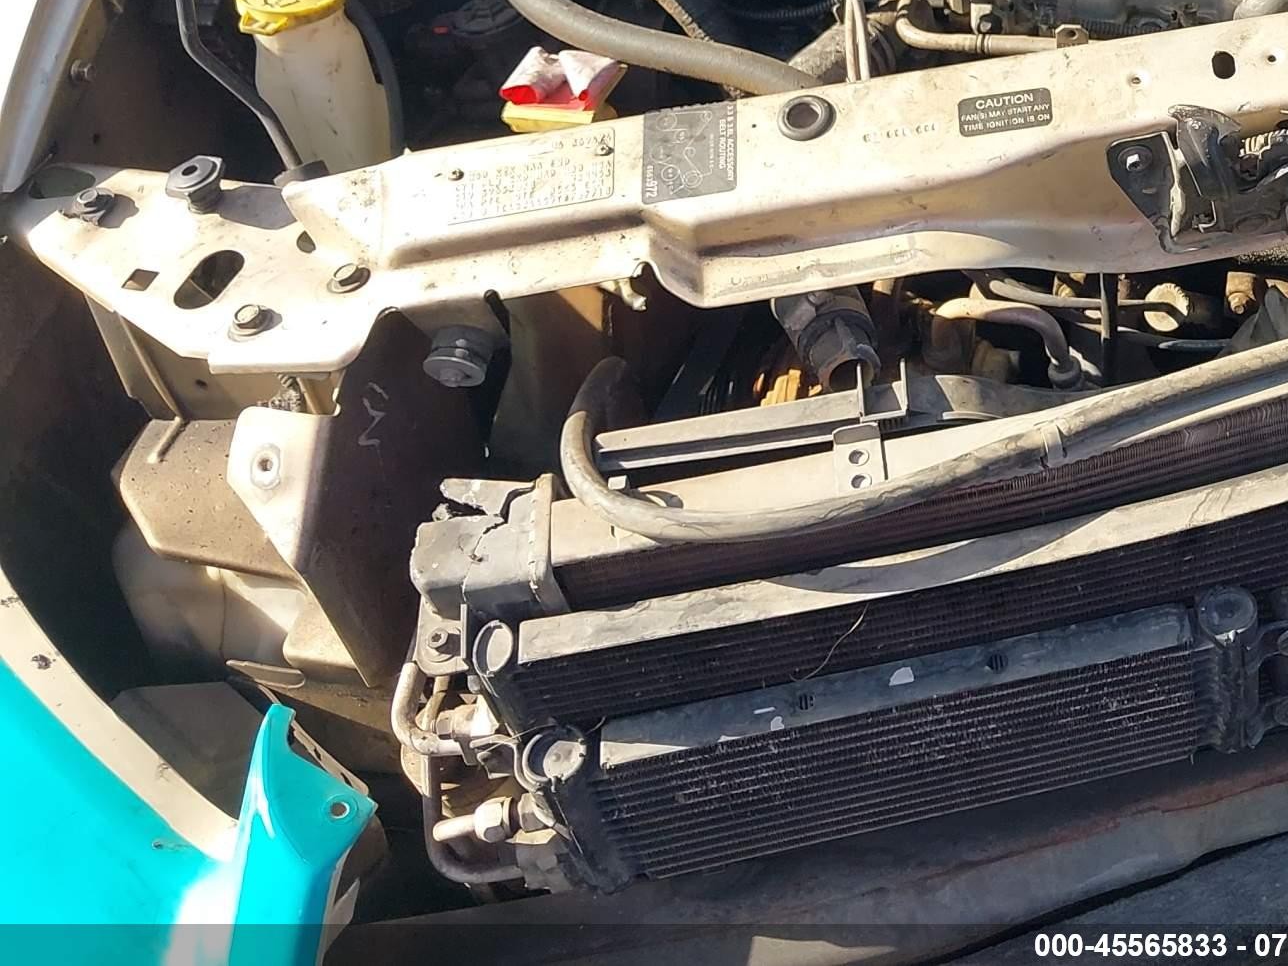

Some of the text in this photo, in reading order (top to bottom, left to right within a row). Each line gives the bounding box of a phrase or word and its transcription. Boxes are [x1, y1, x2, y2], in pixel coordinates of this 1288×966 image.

[975, 92, 1034, 110] CAUTION
[961, 103, 1050, 122] FAN(S) MAY START ANY
[962, 113, 1050, 132] TIME IGNITION IS ON
[718, 119, 727, 170] BELT ROUTING
[727, 138, 735, 181] ACCESSORY
